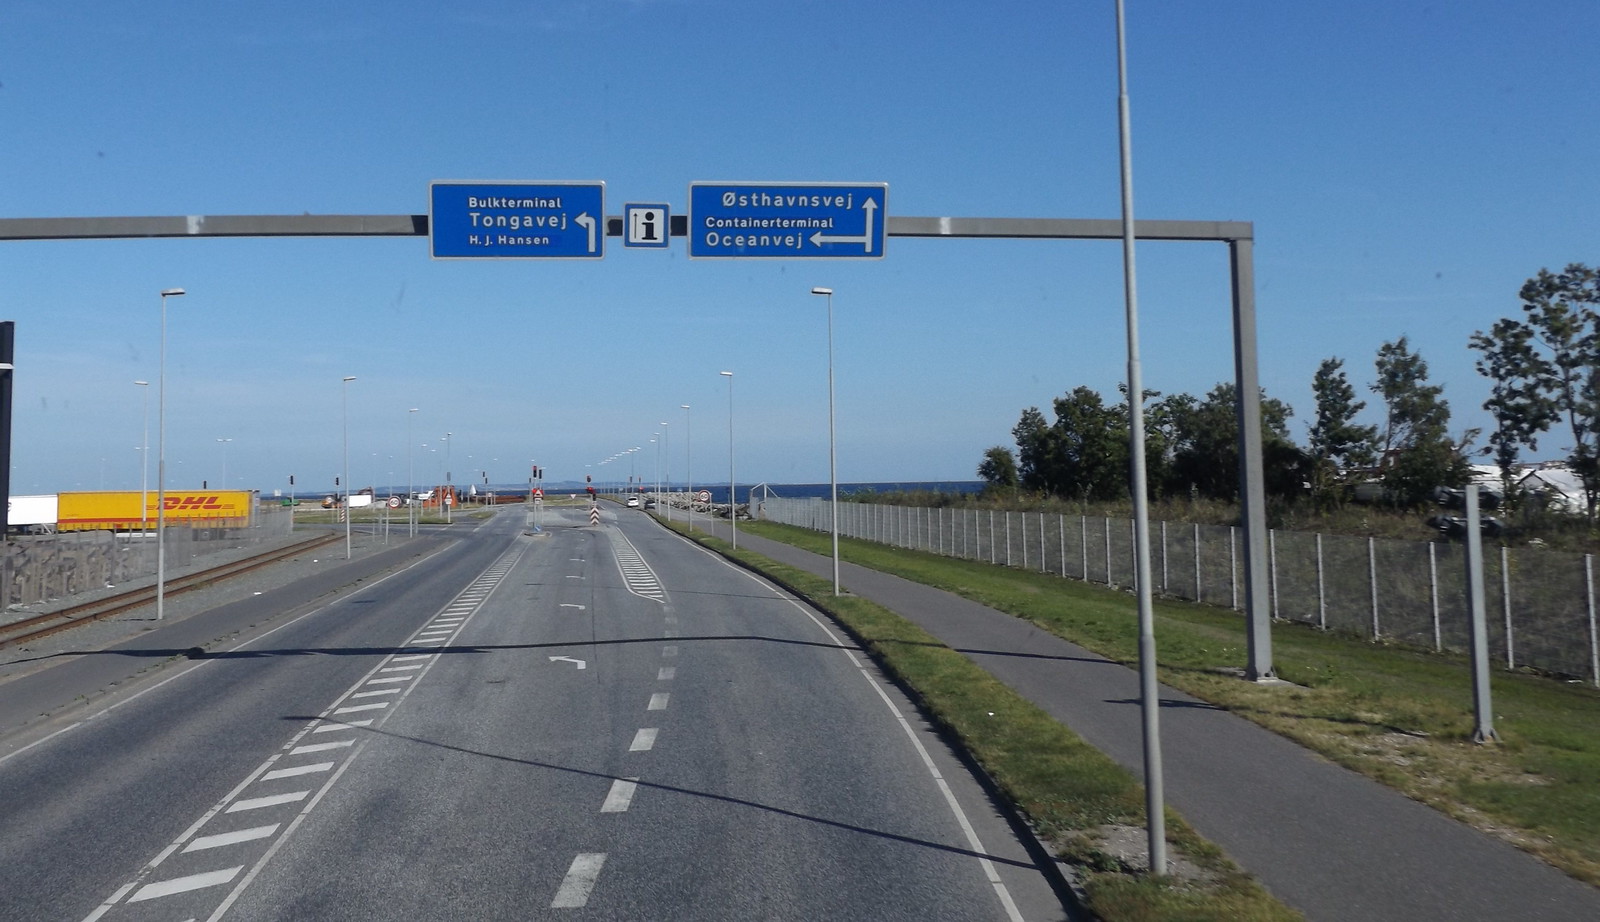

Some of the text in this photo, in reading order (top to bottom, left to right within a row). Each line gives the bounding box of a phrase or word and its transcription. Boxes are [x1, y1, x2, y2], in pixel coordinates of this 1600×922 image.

[468, 197, 561, 208] Bulkterminal
[722, 192, 852, 210] Østhavnsvej
[469, 212, 567, 230] Tongavej
[705, 217, 833, 228] Containerterminal
[498, 235, 549, 245] Hansen
[706, 232, 802, 249] Oceanvej
[157, 496, 222, 510] DHL
